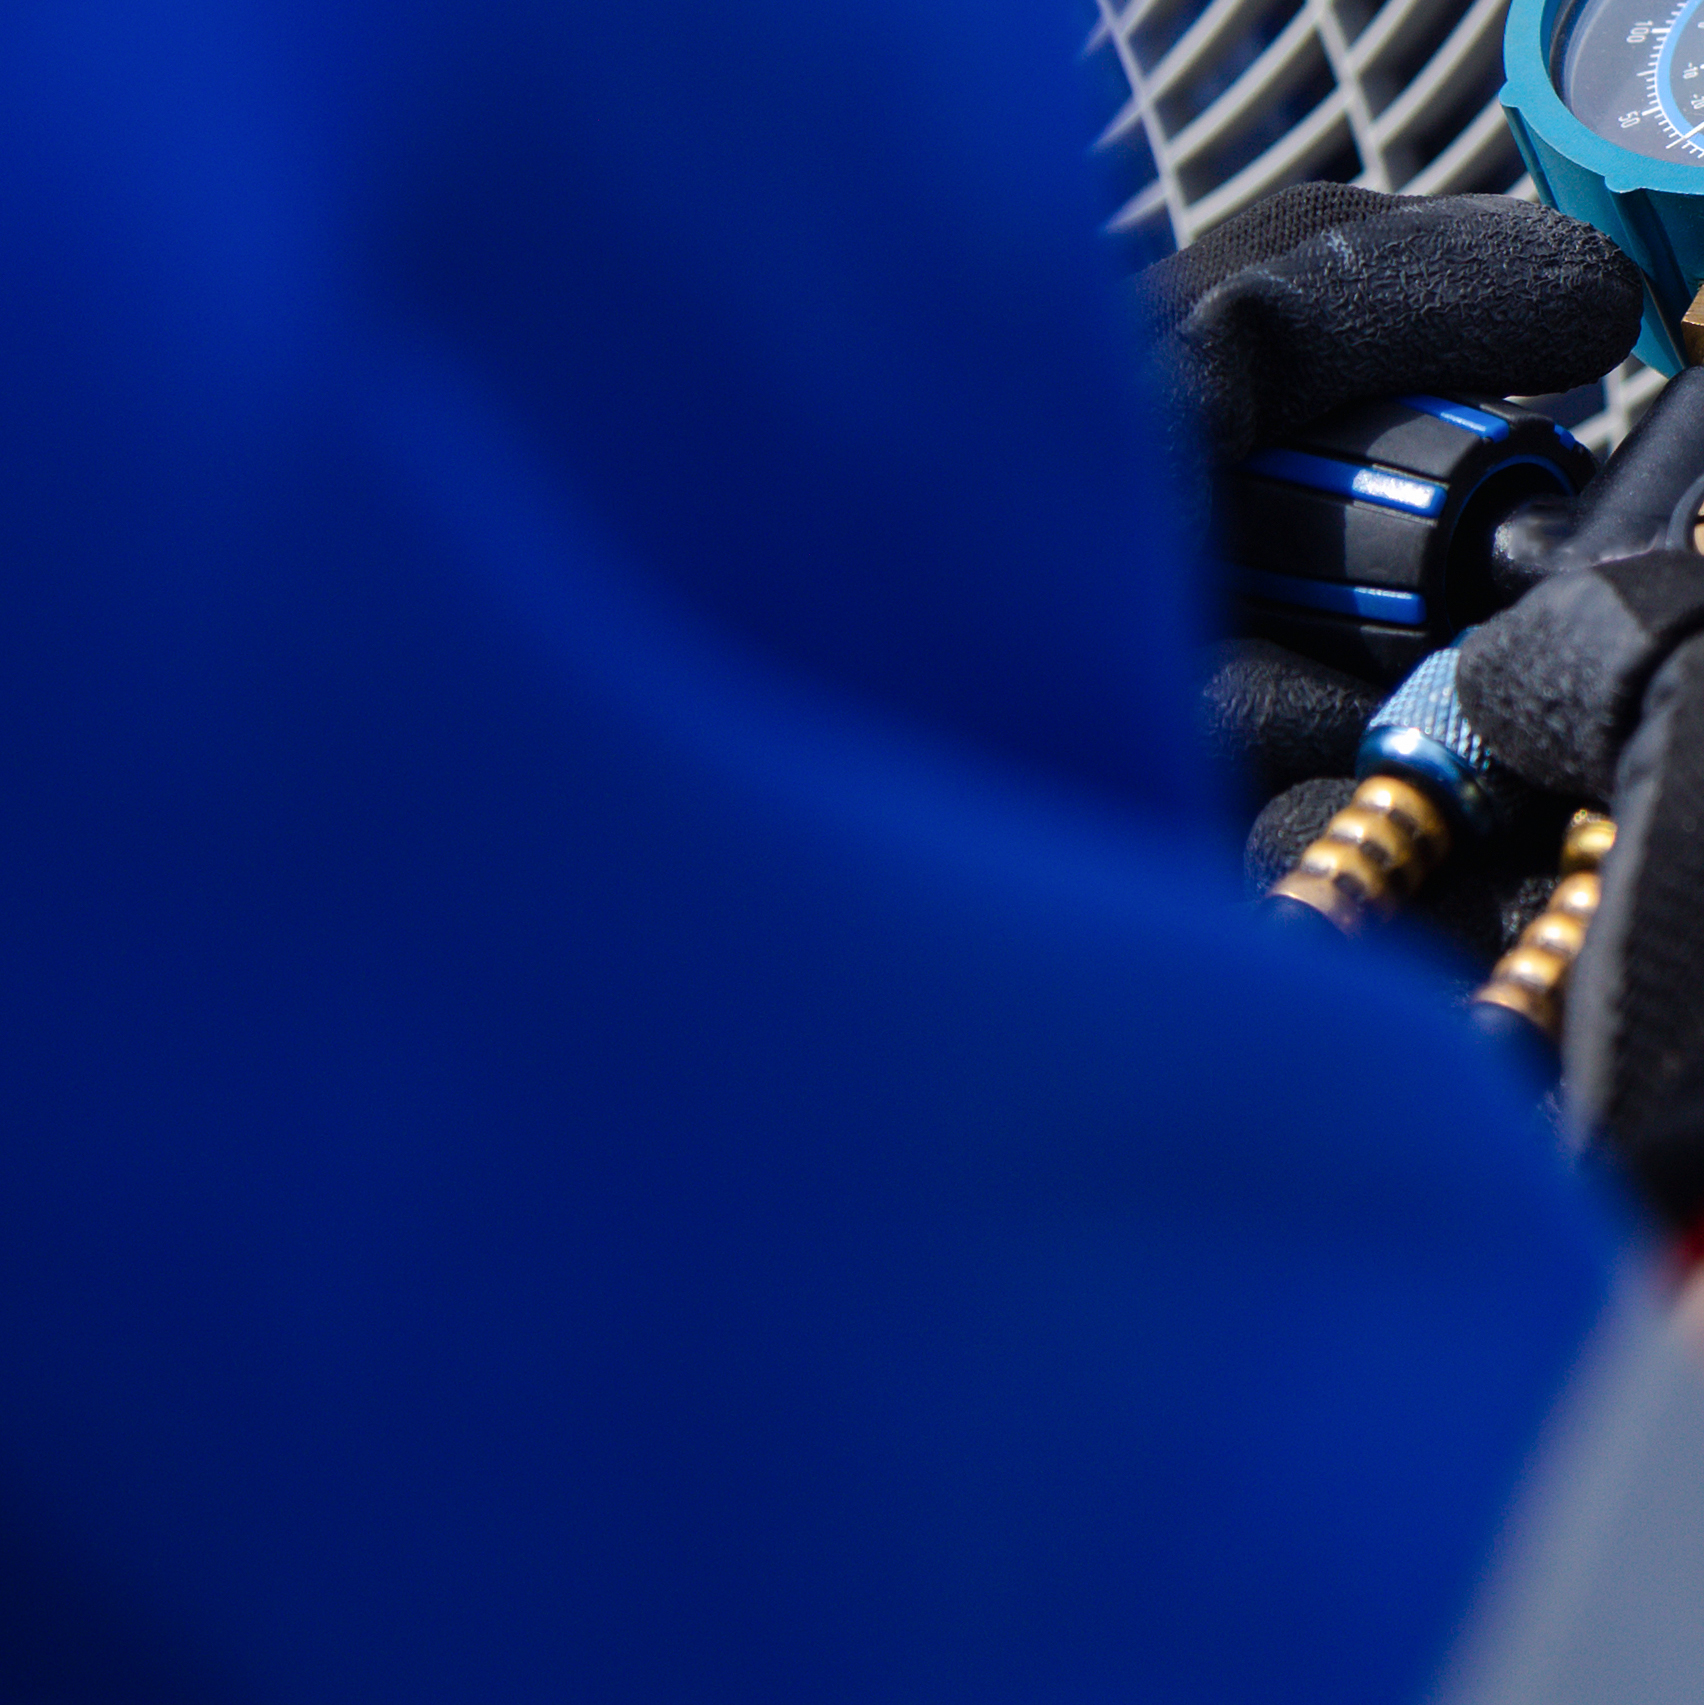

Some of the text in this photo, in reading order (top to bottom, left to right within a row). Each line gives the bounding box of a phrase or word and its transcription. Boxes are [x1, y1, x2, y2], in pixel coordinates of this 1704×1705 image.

[1626, 20, 1653, 43] 100
[1683, 61, 1698, 78] -10
[1618, 110, 1640, 128] 50
